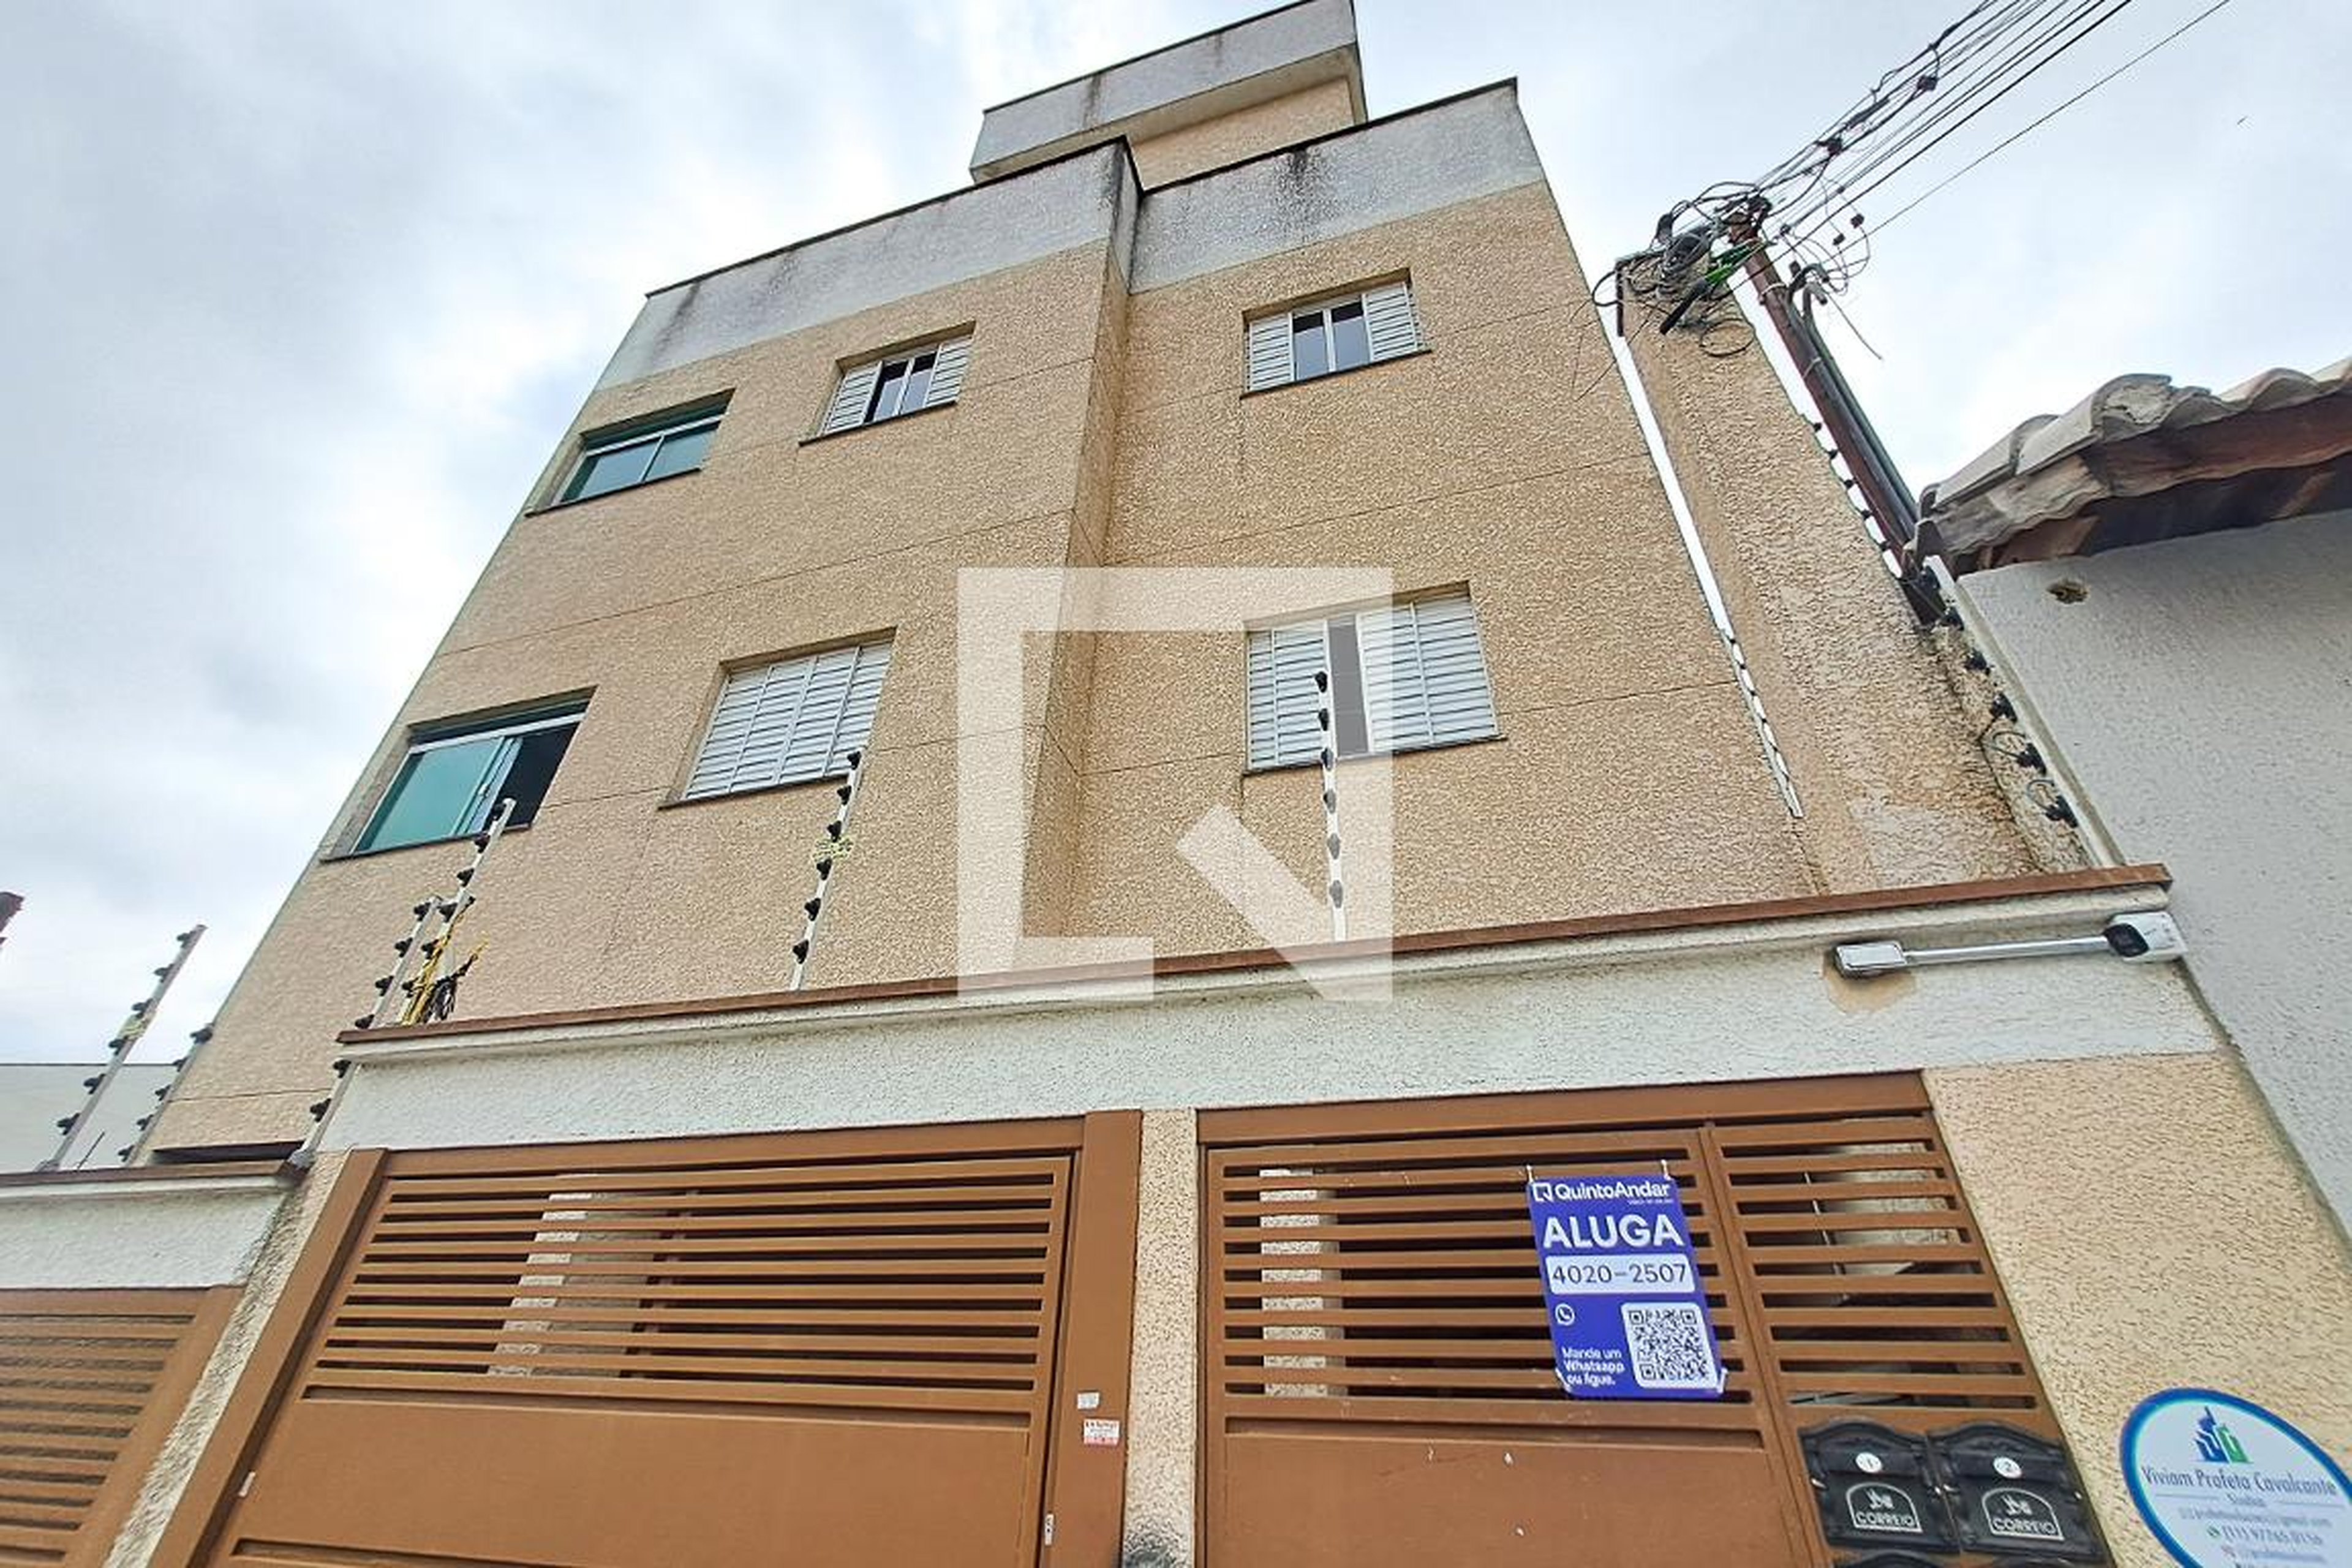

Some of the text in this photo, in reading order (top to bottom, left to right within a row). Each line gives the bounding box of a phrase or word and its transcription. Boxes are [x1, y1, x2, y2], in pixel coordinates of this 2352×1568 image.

[1555, 1180, 1670, 1201] QuintoAndar
[1543, 1213, 1684, 1248] ALUGA
[1552, 1264, 1686, 1284] 4020-2507
[1856, 1510, 1915, 1526] CORREIO
[1992, 1517, 2056, 1534] CORREIO
